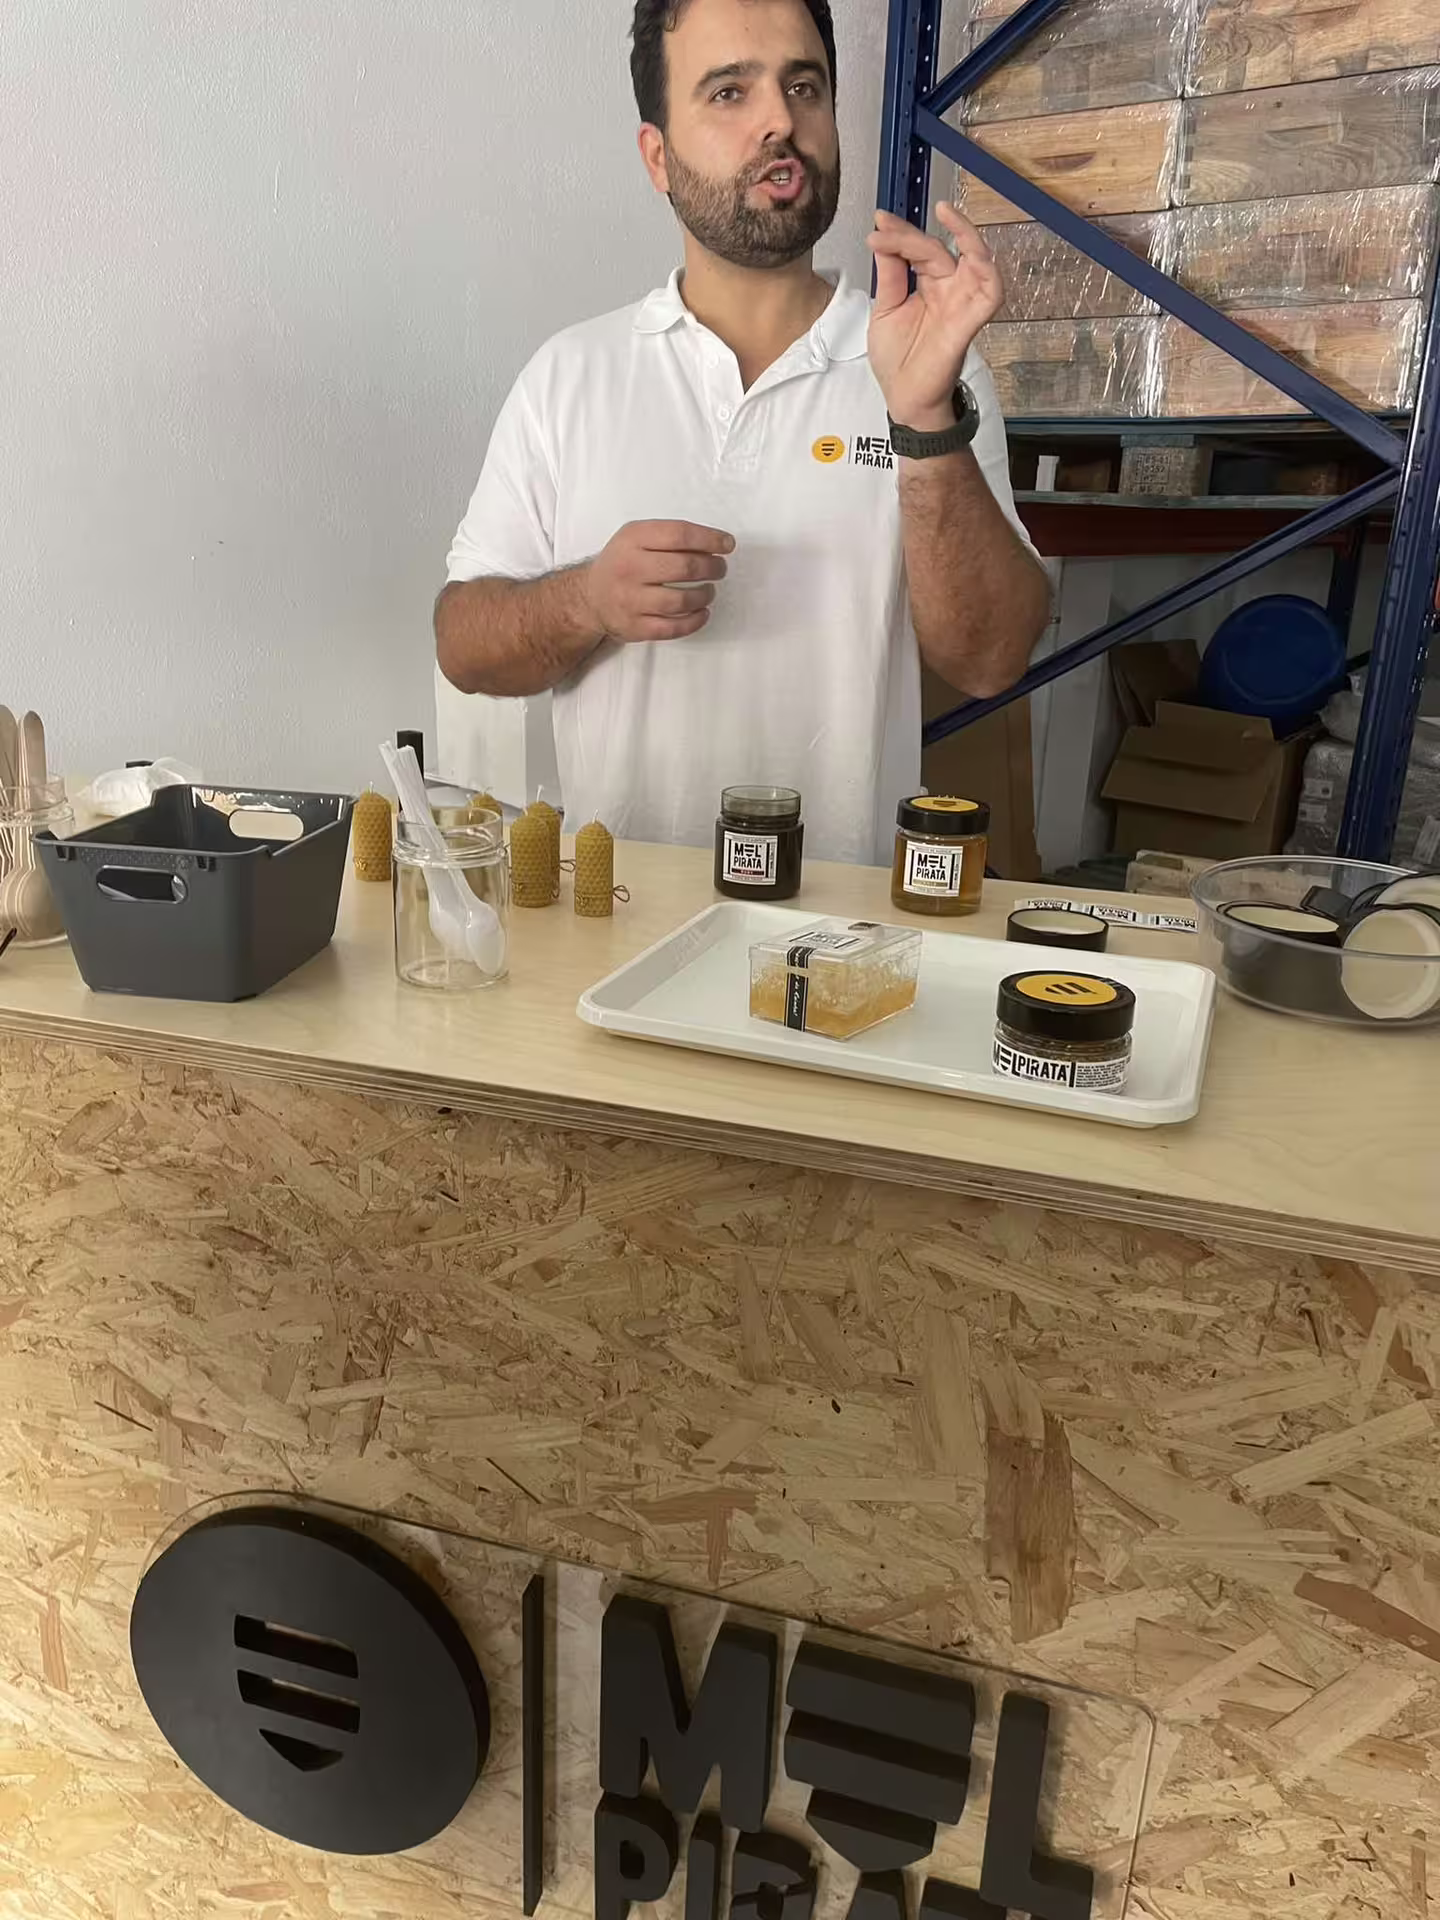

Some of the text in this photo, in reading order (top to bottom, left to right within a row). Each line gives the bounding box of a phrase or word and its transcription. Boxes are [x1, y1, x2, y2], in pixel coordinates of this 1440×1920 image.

[856, 436, 893, 455] MEL
[854, 452, 893, 469] PIRATA
[734, 842, 762, 858] MEL
[733, 856, 762, 869] PIRATA
[917, 853, 947, 869] MEL
[916, 867, 946, 880] PIRATA
[1017, 1054, 1068, 1082] PIRATA
